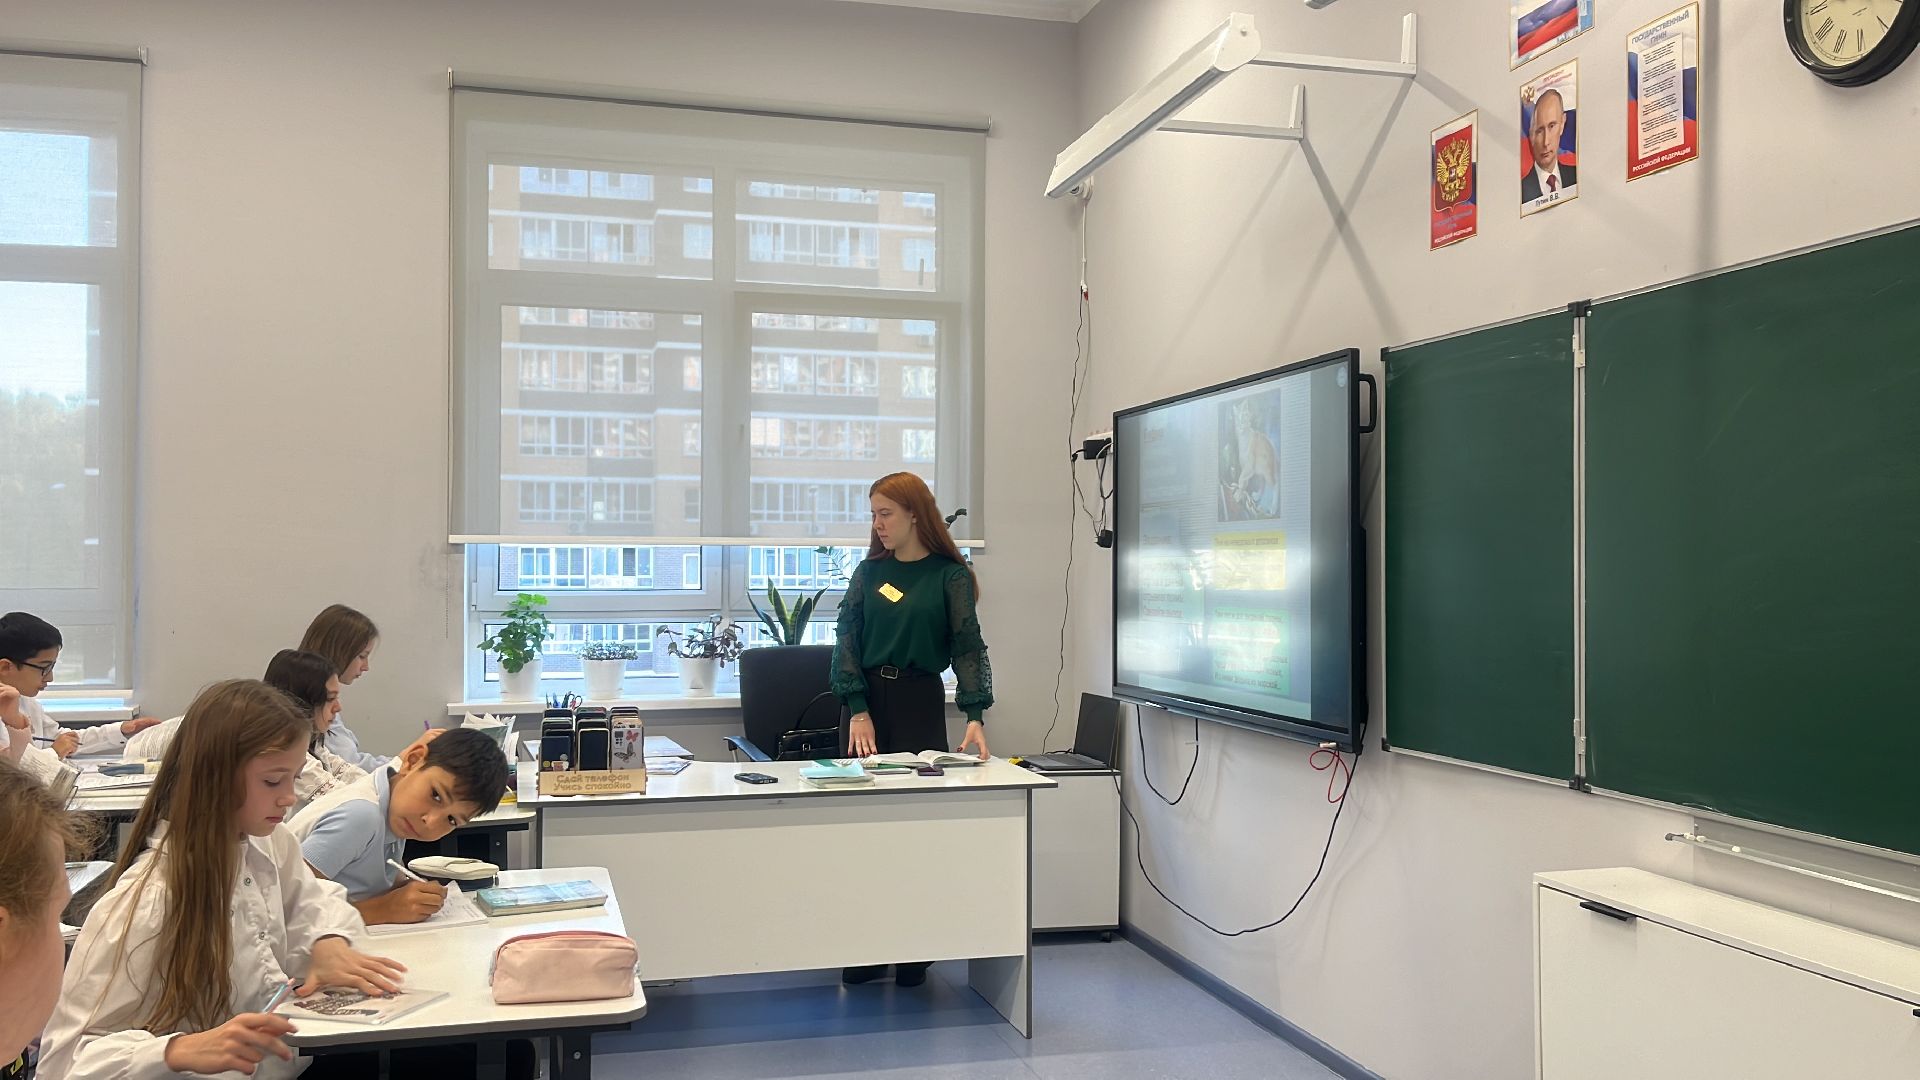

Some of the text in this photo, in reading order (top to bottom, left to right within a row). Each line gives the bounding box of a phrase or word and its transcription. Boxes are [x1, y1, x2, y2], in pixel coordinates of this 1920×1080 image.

[585, 774, 629, 782] телефон
[554, 782, 631, 791] Учись спокойно
